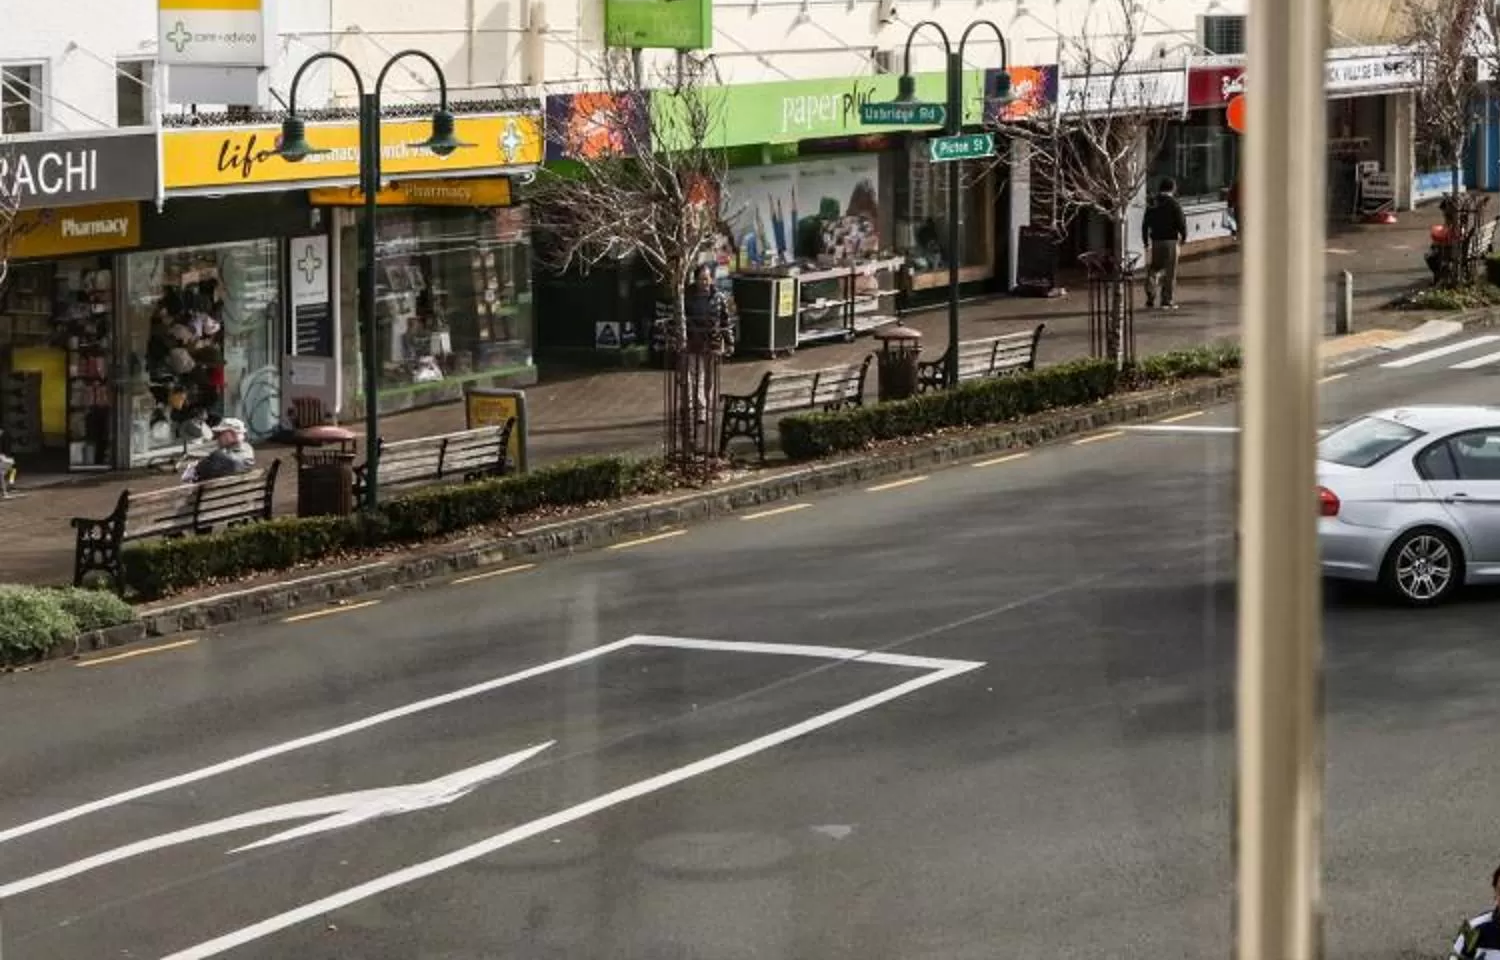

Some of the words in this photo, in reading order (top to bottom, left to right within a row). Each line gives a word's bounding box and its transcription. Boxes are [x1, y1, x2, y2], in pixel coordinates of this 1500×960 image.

[780, 94, 838, 133] paper
[865, 106, 914, 123] Uxbridge
[919, 107, 936, 118] Rd
[939, 141, 969, 154] Picton
[972, 139, 984, 151] St
[404, 183, 472, 201] Pharmacy
[61, 217, 129, 237] Pharmacy
